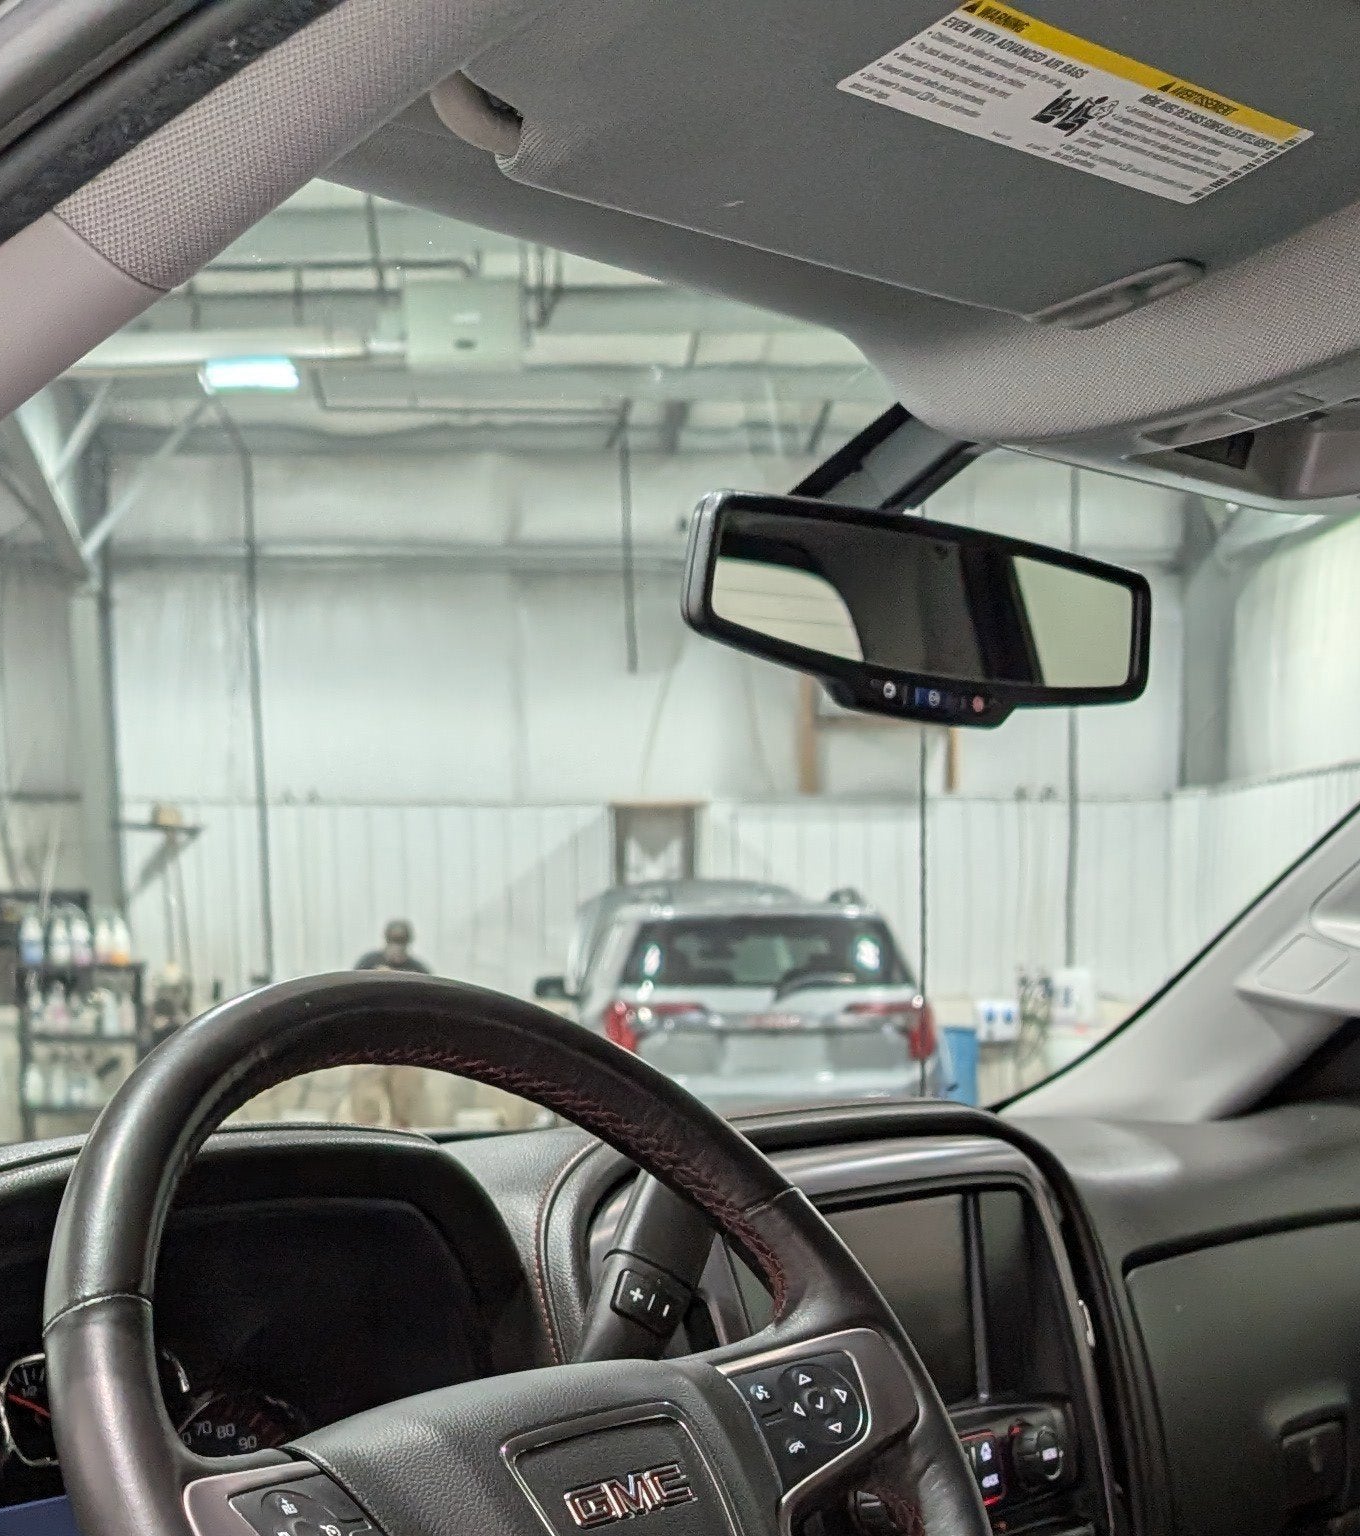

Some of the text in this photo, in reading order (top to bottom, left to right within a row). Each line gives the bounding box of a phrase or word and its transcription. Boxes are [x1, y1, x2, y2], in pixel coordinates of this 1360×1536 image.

[978, 5, 1030, 33] WARNING
[942, 16, 1088, 79] EVEN WITH ADVANCED AIR BAGS
[238, 1435, 258, 1451] 90
[564, 1463, 696, 1529] GMC
